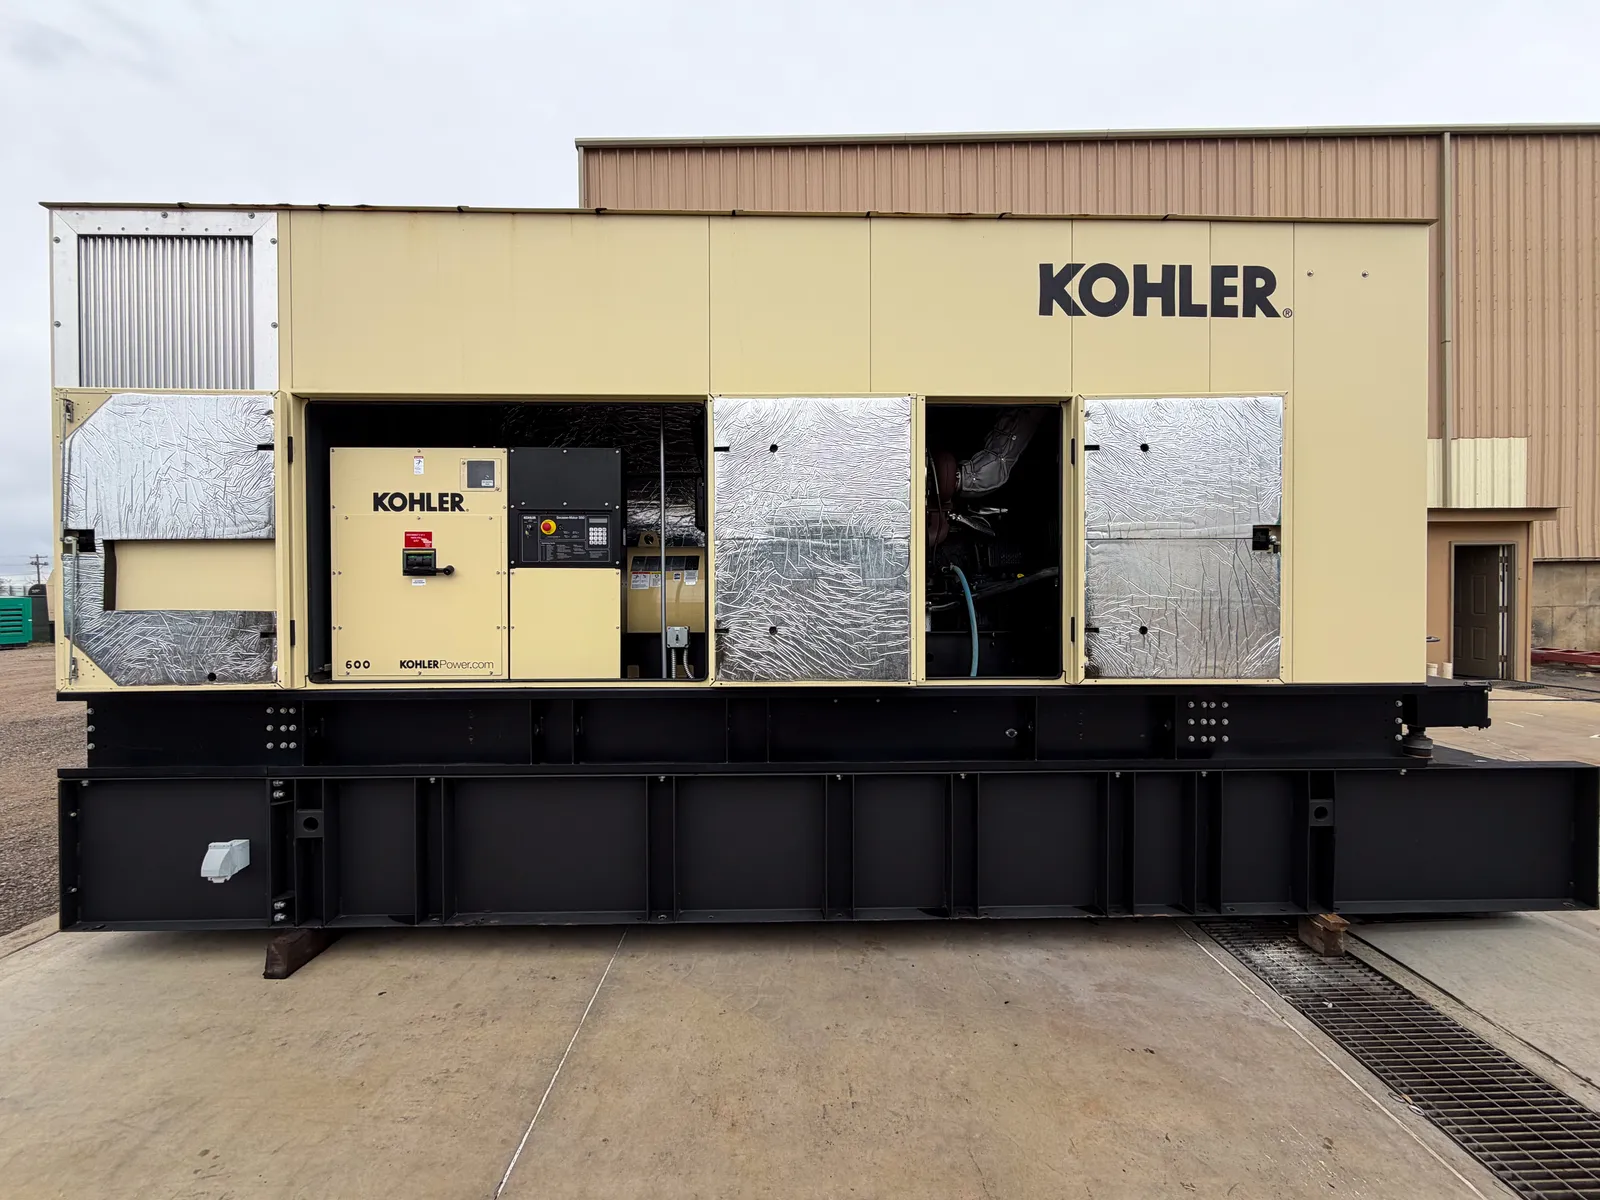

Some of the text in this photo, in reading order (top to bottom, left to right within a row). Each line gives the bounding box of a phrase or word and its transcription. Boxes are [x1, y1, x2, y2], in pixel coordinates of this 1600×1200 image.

[1039, 262, 1281, 318] KOHLER
[373, 492, 466, 512] KOHLER
[345, 660, 371, 669] 600
[399, 659, 494, 669] KOHLERPower.com
